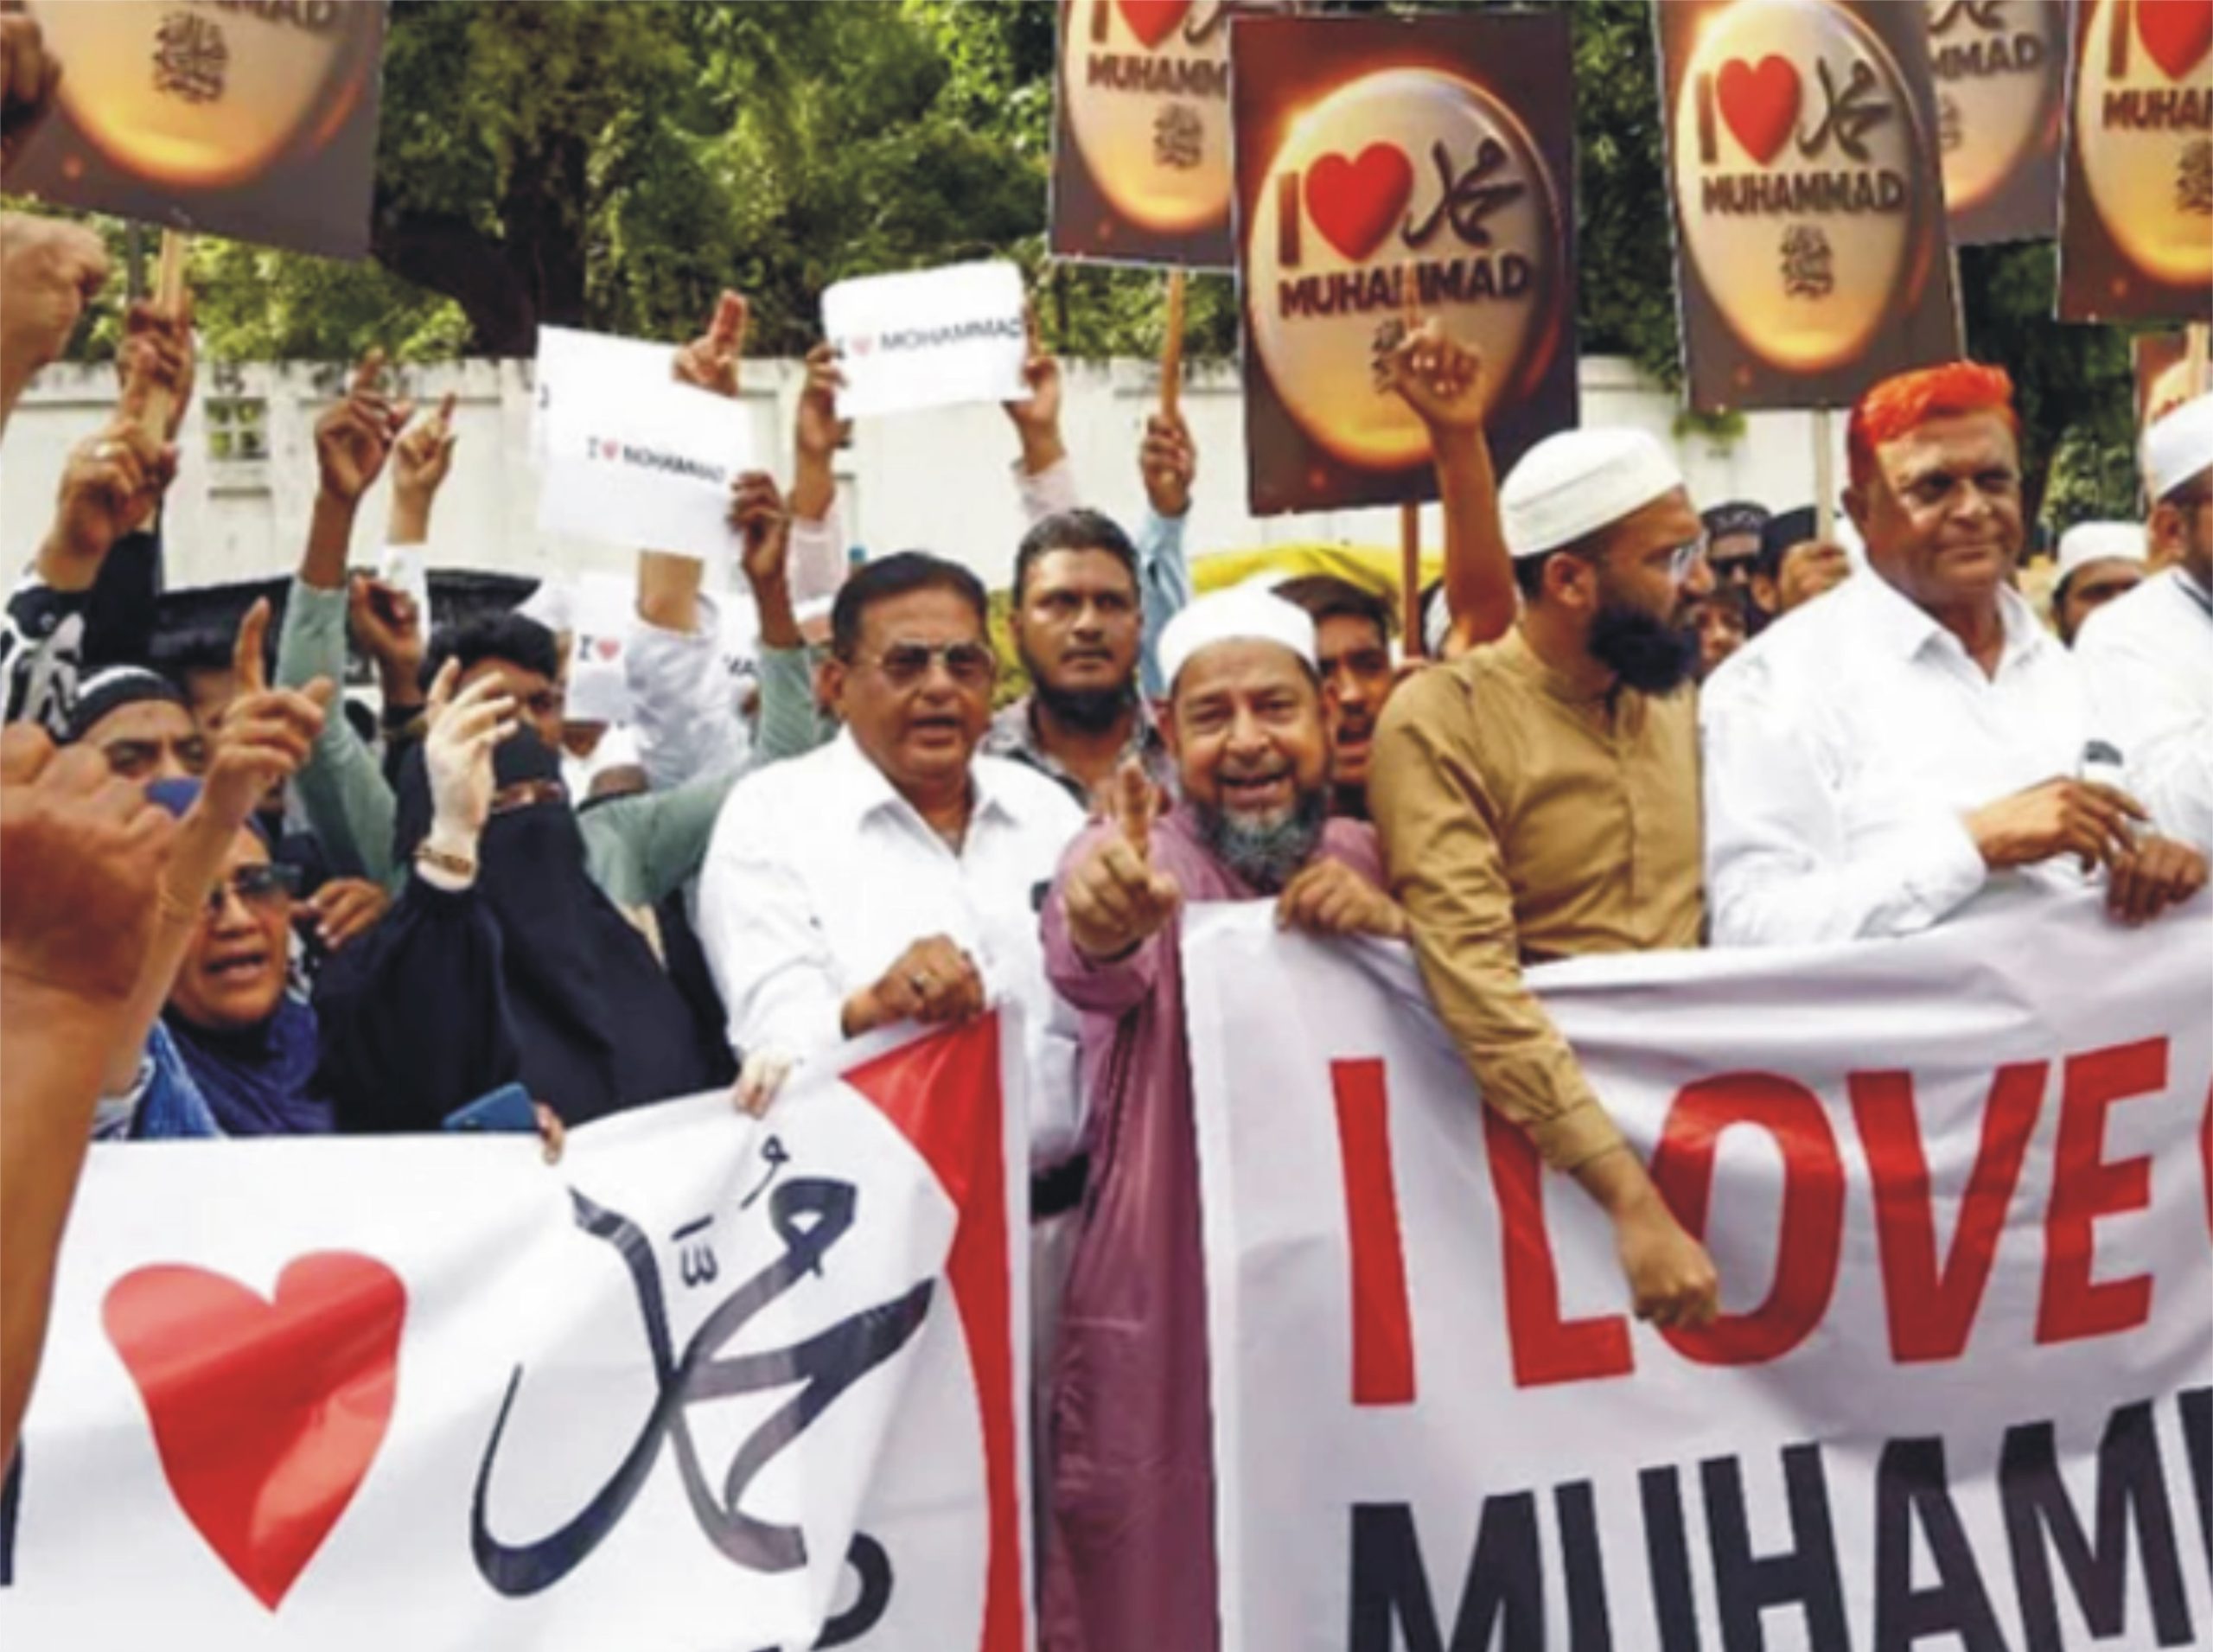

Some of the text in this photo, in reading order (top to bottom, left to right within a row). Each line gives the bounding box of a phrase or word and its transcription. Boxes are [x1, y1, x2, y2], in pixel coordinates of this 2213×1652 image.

[1697, 73, 1719, 164] I
[1279, 171, 1300, 269] I
[1702, 170, 1906, 214] MUHAMMAD
[1330, 1035, 2171, 1406] I LOVE
[1346, 1385, 2213, 1652] MUHAM
